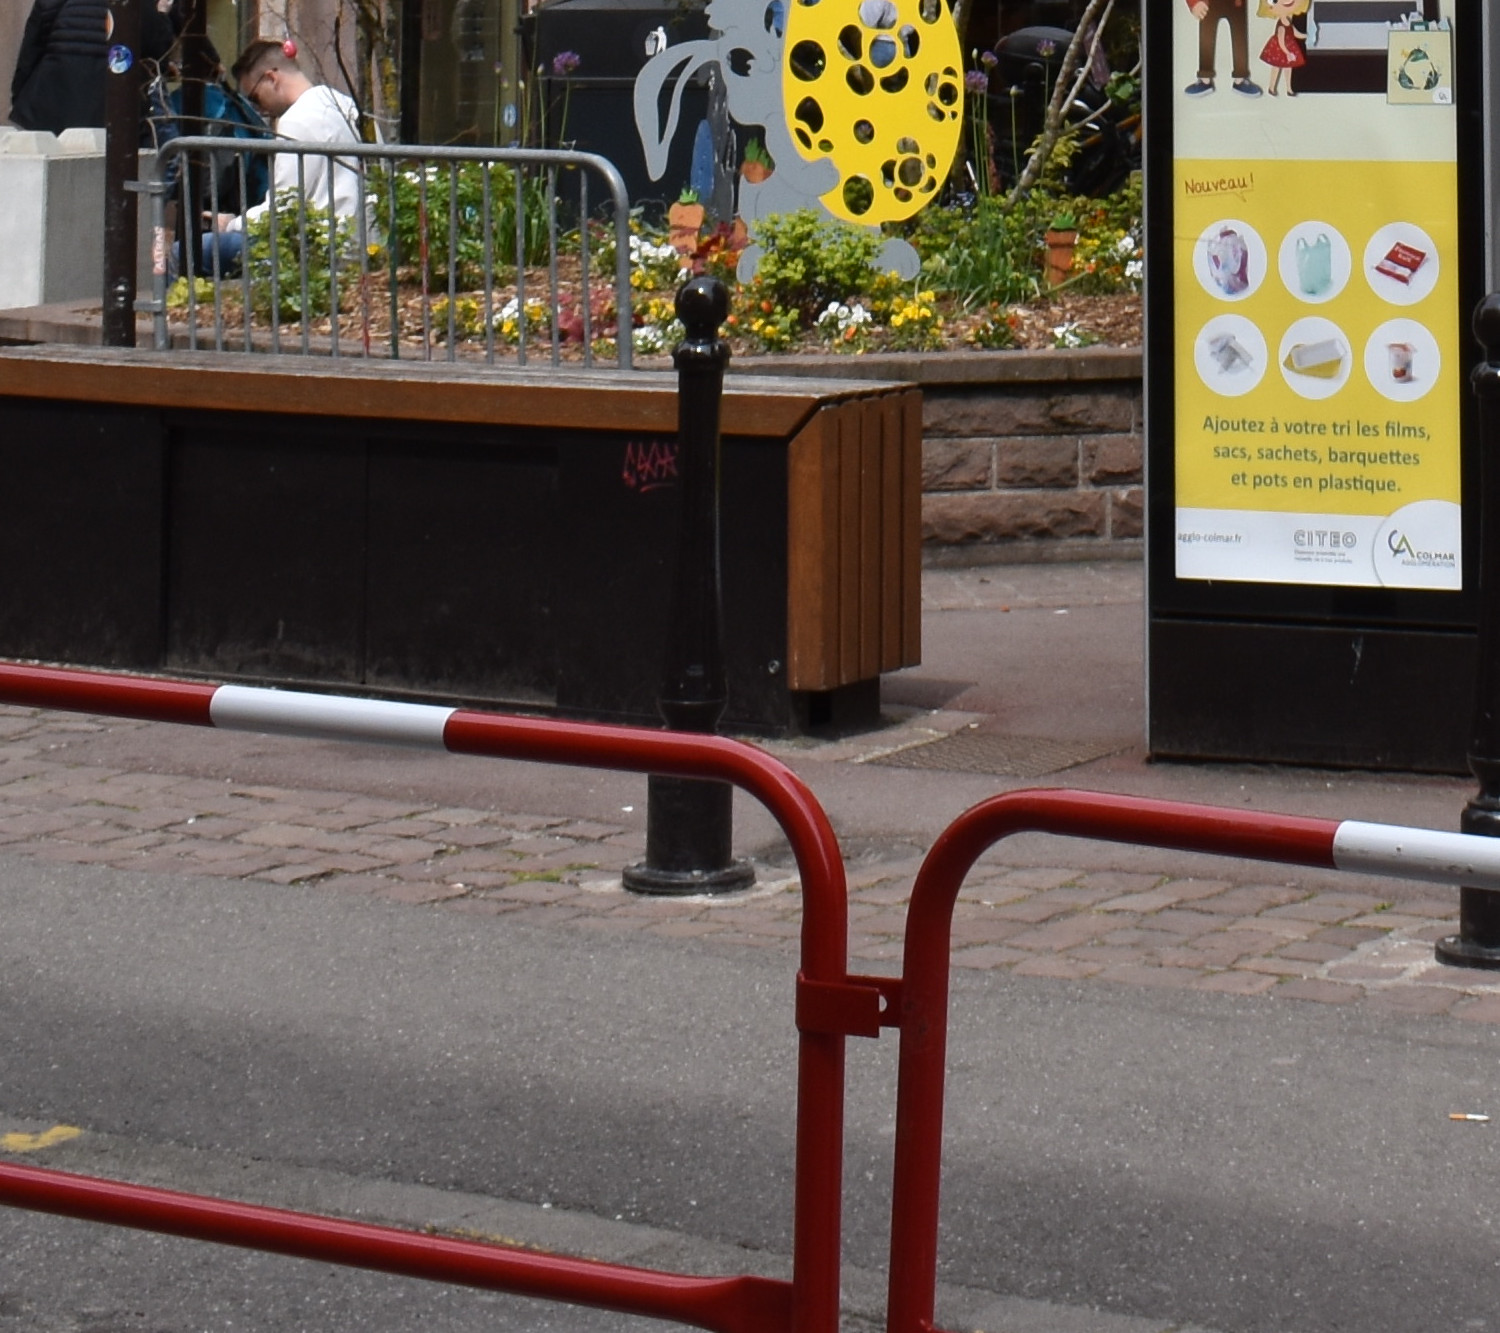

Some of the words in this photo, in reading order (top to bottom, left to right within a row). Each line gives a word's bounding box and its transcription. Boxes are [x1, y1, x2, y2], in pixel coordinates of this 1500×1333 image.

[1203, 415, 1264, 434] Ajoutez
[1270, 417, 1279, 433] à
[1284, 420, 1327, 436] votre
[1332, 420, 1351, 436] tri
[1357, 420, 1380, 437] les
[1385, 420, 1431, 440] films,
[1213, 445, 1252, 461] sacs,
[1257, 445, 1323, 464] sachets,
[1328, 447, 1420, 466] barquettes
[1231, 472, 1247, 485] et
[1253, 473, 1288, 489] pots
[1293, 476, 1313, 489] en
[1318, 474, 1402, 494] plastique.
[1293, 529, 1357, 548] CITEO
[1416, 551, 1455, 561] COLMAR
